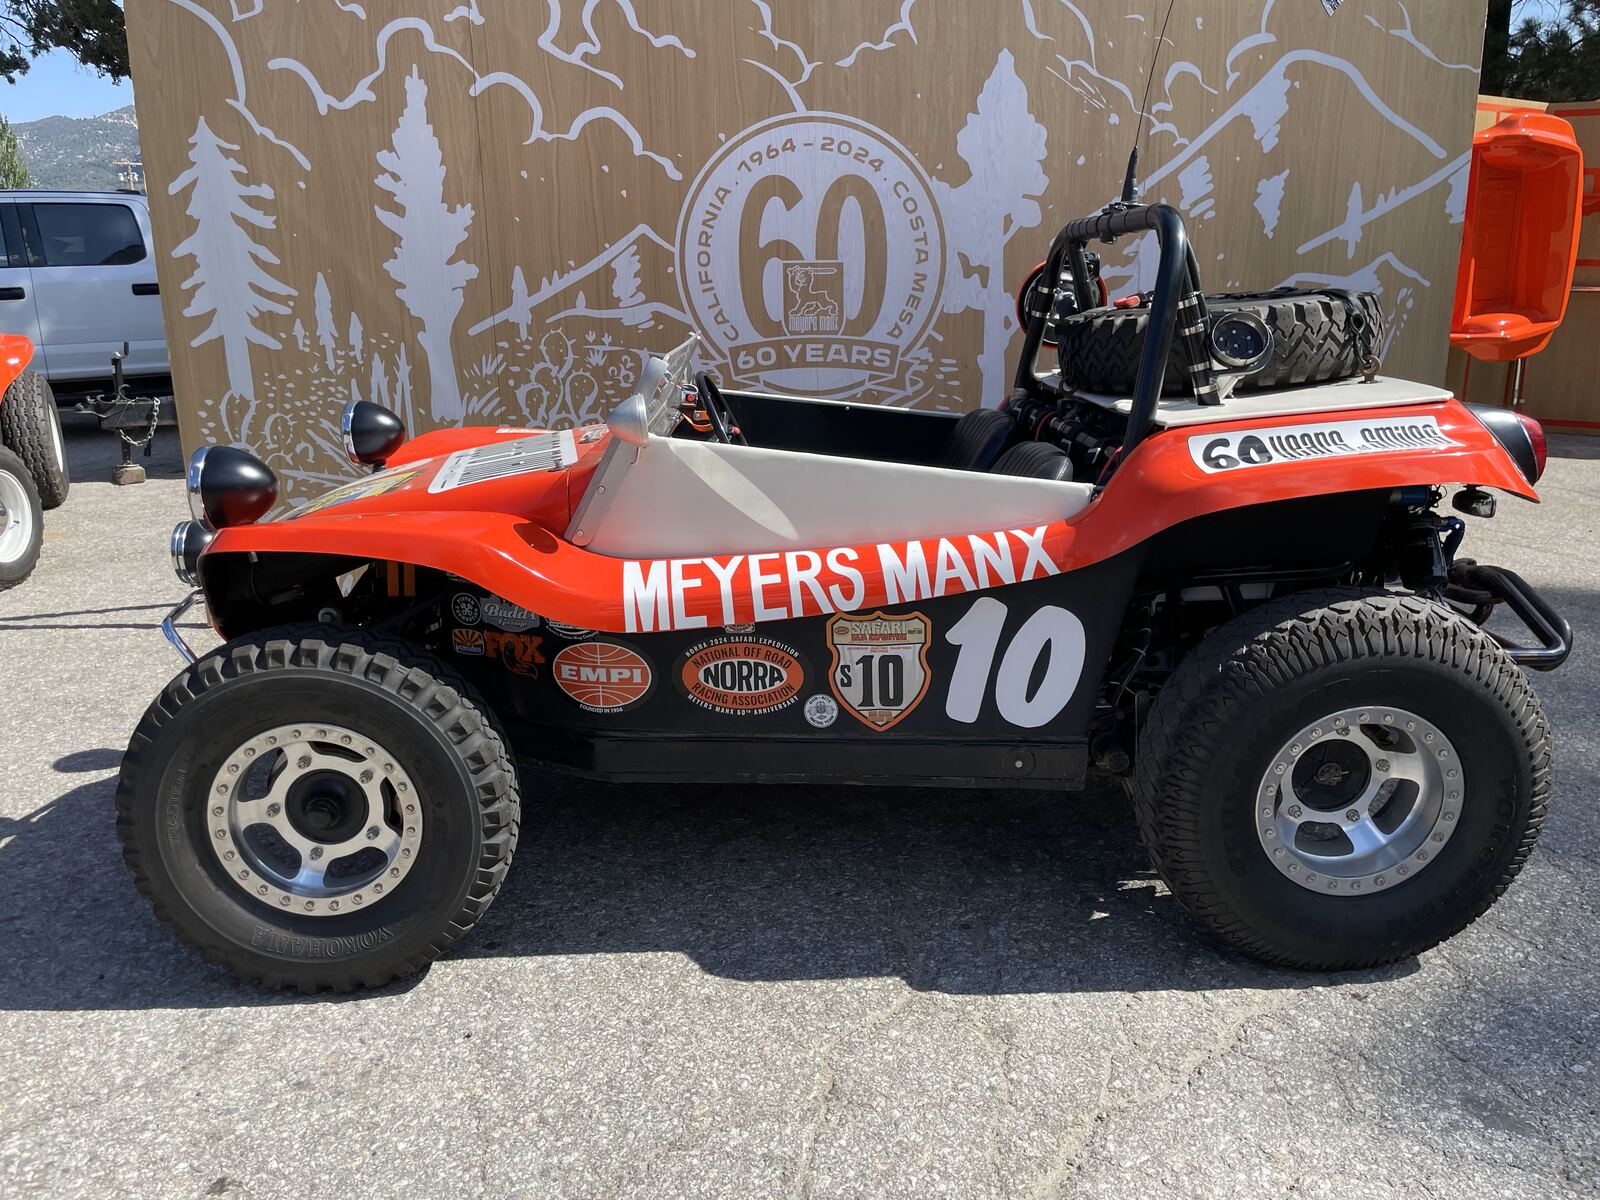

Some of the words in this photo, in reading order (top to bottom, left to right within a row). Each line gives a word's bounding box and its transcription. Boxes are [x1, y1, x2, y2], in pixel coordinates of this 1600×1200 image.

[737, 137, 796, 173] 1964
[820, 136, 884, 173] 2024
[892, 180, 929, 266] COSTA
[697, 186, 740, 342] CALIFORNIA
[738, 173, 888, 340] 60
[887, 272, 928, 340] MESA
[736, 348, 778, 370] 60
[783, 343, 892, 368] YEARS
[1202, 434, 1274, 470] 60
[622, 547, 865, 633] MEYERS
[875, 525, 1061, 606] MANX
[850, 620, 908, 635] SAFARI
[484, 630, 546, 667] FOX
[685, 641, 708, 658] NORRA
[709, 637, 728, 648] 2024
[730, 635, 757, 644] SAFARI
[759, 636, 800, 659] EXPEDITION
[691, 646, 741, 669] NATIONAL
[743, 646, 762, 658] OFF
[764, 650, 793, 670] ROAD
[944, 597, 1087, 729] 10
[560, 663, 643, 684] EMPI
[703, 660, 785, 692] NORRA
[855, 654, 904, 708] 10
[579, 703, 604, 713] FOUNDED
[687, 692, 714, 711] MEYERS
[714, 705, 735, 715] MANX
[753, 695, 800, 717] ANNIVERSARY
[691, 682, 729, 705] RACING
[731, 682, 796, 706] ASSOCIATION
